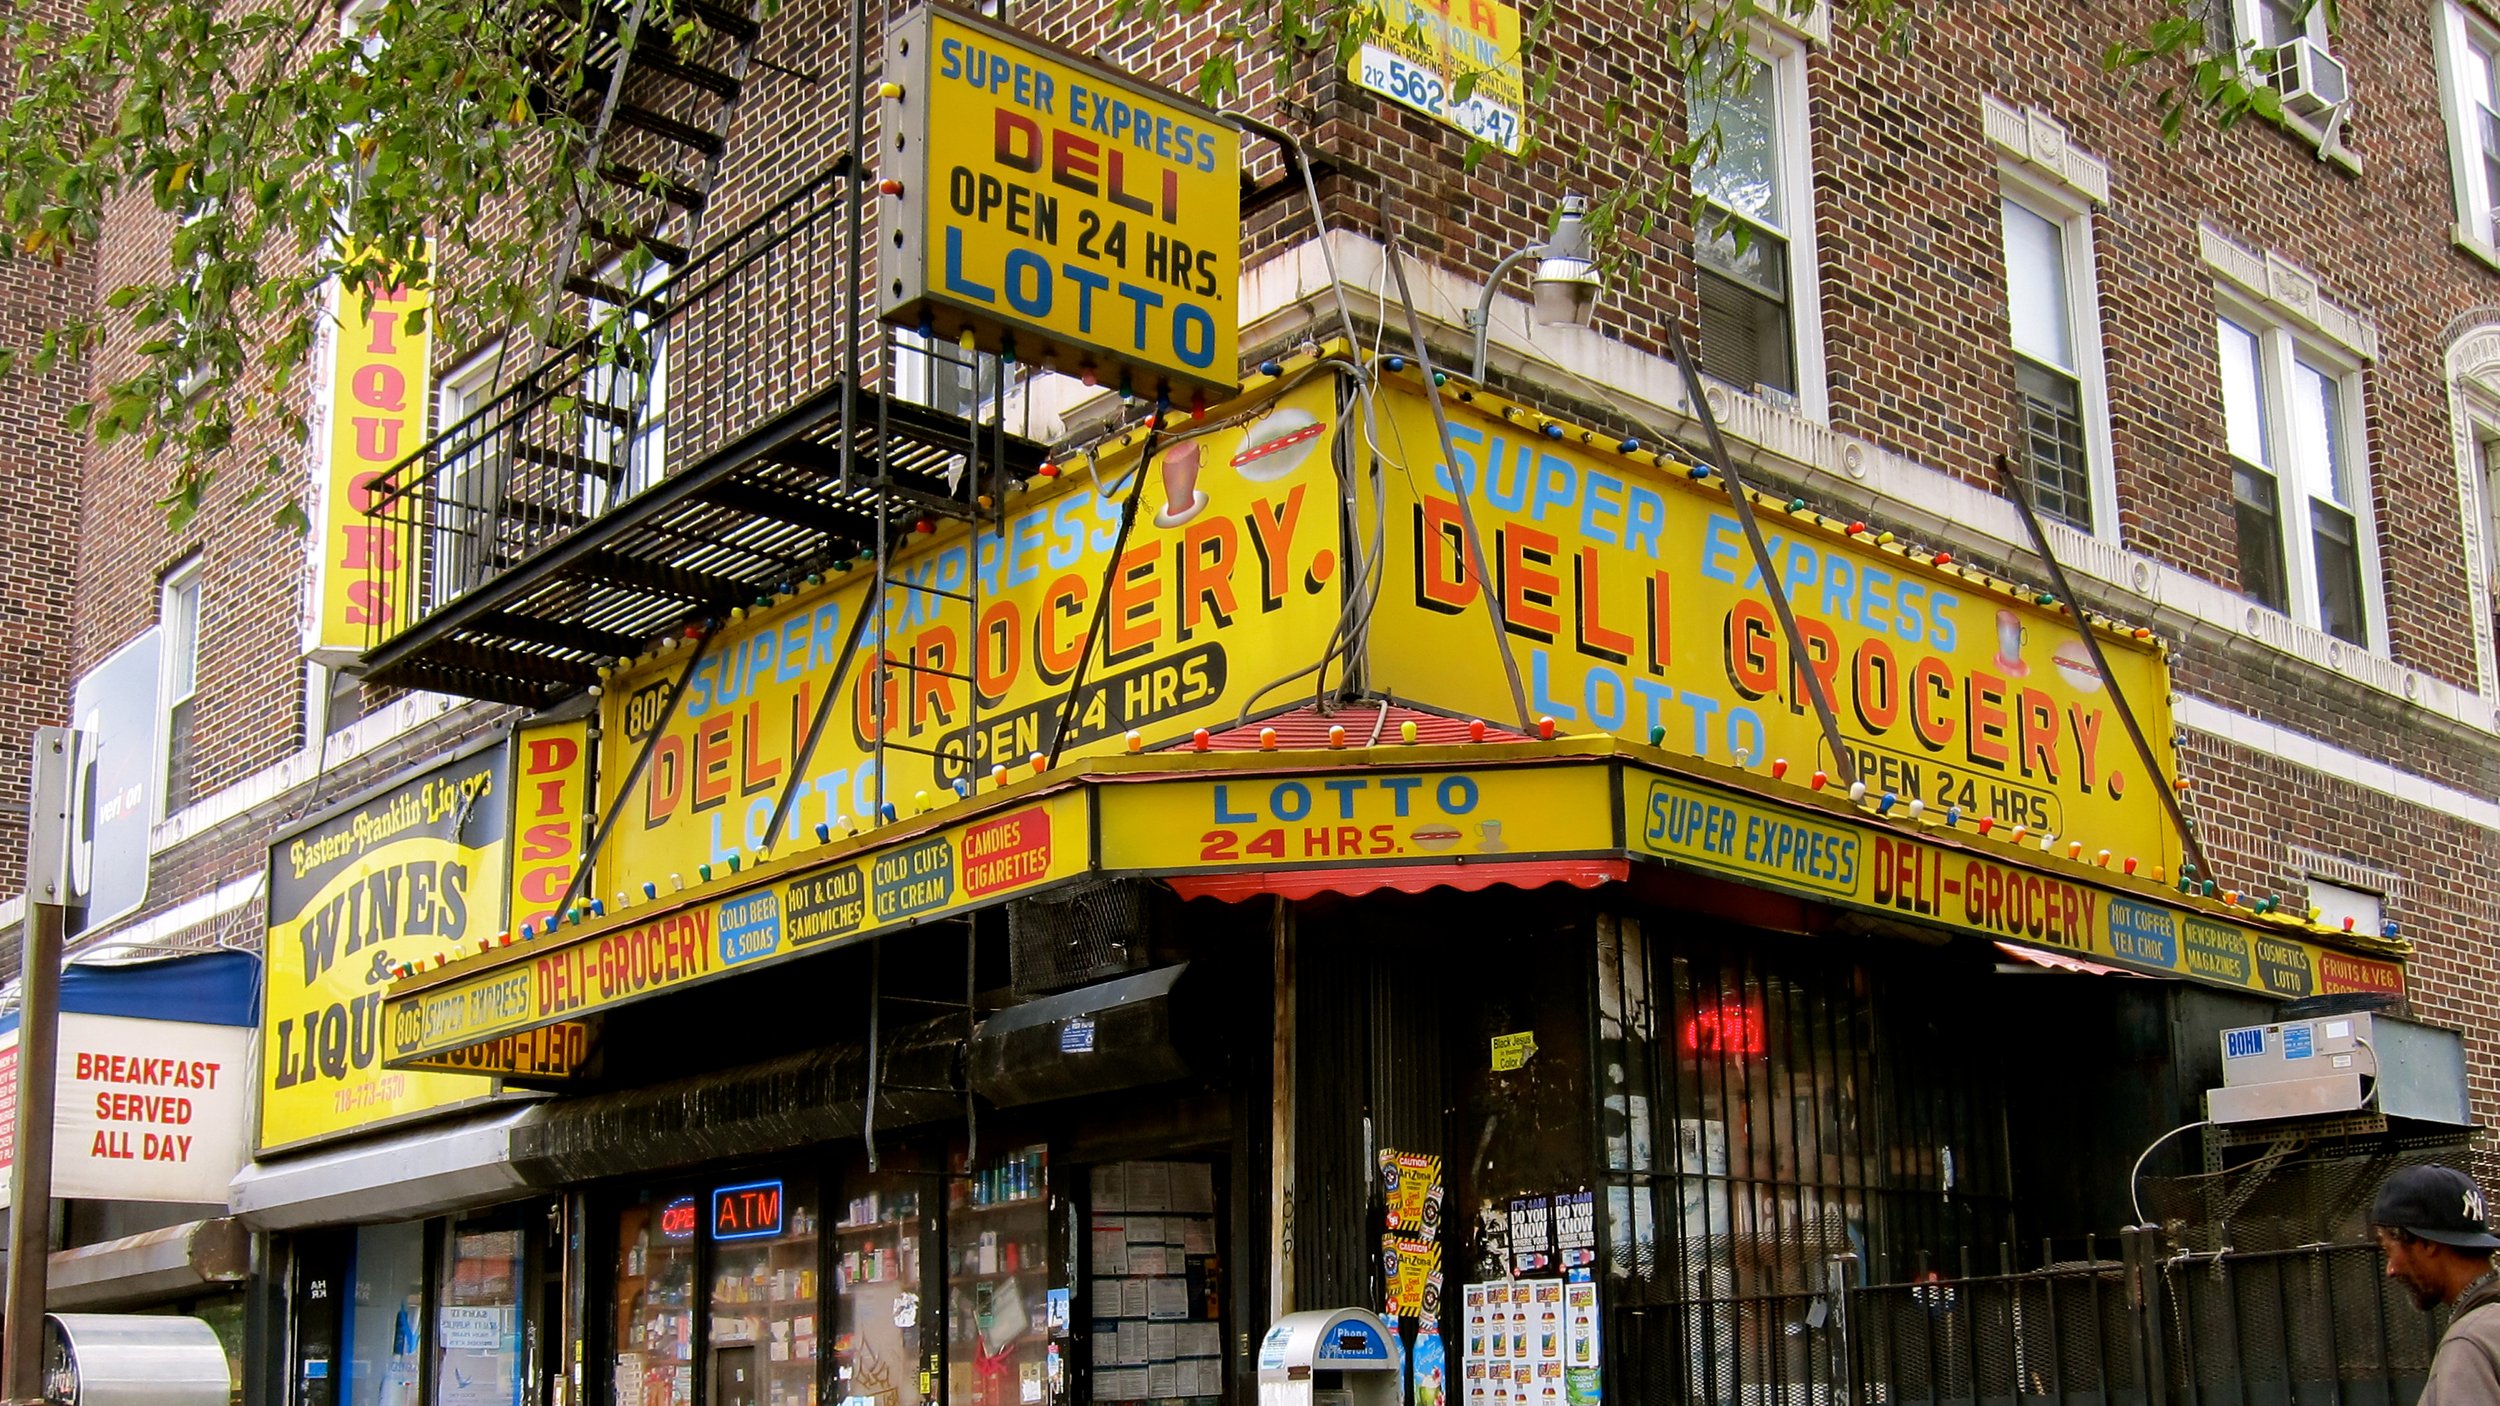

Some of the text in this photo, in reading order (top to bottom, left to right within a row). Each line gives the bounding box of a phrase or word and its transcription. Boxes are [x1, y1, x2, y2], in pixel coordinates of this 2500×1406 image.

[941, 37, 1215, 172] SUPER EXPRESS
[1364, 65, 1385, 89] 212
[1390, 60, 1445, 116] 562
[994, 107, 1177, 225] DELI
[950, 165, 1222, 301] OPEN 24 HRS.
[945, 225, 1215, 369] LOTTO
[1434, 420, 1959, 653] SUPER EXPRESS
[687, 474, 1134, 718] SUPER EXPRESS
[1413, 495, 1671, 677] DELI
[942, 710, 1039, 780] OPEN
[1124, 654, 1215, 722] HRS.
[1531, 649, 1765, 768] LOTTO
[644, 681, 810, 829] DELI
[1214, 775, 1480, 824] LOTTO
[1937, 771, 1977, 813] 24
[1991, 785, 2052, 832] HRS.
[966, 822, 1021, 859] CANDIES
[1200, 825, 1404, 861] 24 HRS.
[1649, 793, 1856, 884] SUPER EXPRESS
[876, 844, 949, 886] COLD CUTS
[966, 847, 1047, 891] CIGARETTES
[788, 873, 857, 910] HOT & COLD
[877, 877, 944, 917] ICE CREAM
[1874, 837, 2097, 951] DELI-GROCERY
[300, 861, 467, 988] WINES
[720, 895, 777, 933] COLD BEER
[789, 902, 862, 942] SANDWICHES
[2112, 904, 2172, 937] HOT COFFEE
[726, 927, 773, 959] & SODAS
[2114, 932, 2164, 961] TEA CHOC
[2185, 924, 2246, 956] NEWSPAPERS
[2257, 941, 2307, 970] COSMETICS
[365, 949, 397, 986] &
[538, 909, 710, 1016] DELI-GROCERY
[2187, 949, 2242, 979] MAGAZINES
[2273, 968, 2301, 991] LOTTO
[2323, 958, 2397, 988] FRUITS & VEG.
[470, 976, 528, 1025] EXPRESS
[397, 1008, 421, 1046] 806
[2228, 1029, 2264, 1057] BOHN
[76, 1052, 221, 1090] BREAKFAST
[96, 1092, 192, 1125] SERVED
[91, 1129, 193, 1164] ALL DAY
[1399, 1157, 1427, 1167] CAUTION
[719, 1192, 778, 1229] ATM
[1511, 1197, 1547, 1211] IT'S 4AM
[1511, 1208, 1547, 1224] DO YOU
[1555, 1192, 1592, 1206] IT'S 4AM
[1556, 1202, 1593, 1219] DO YOU
[661, 1206, 695, 1232] OPE
[1512, 1221, 1548, 1239] KNOW
[1556, 1216, 1593, 1234] KNOW
[1399, 1242, 1428, 1253] CAUTION
[1337, 1328, 1368, 1337] Phone
